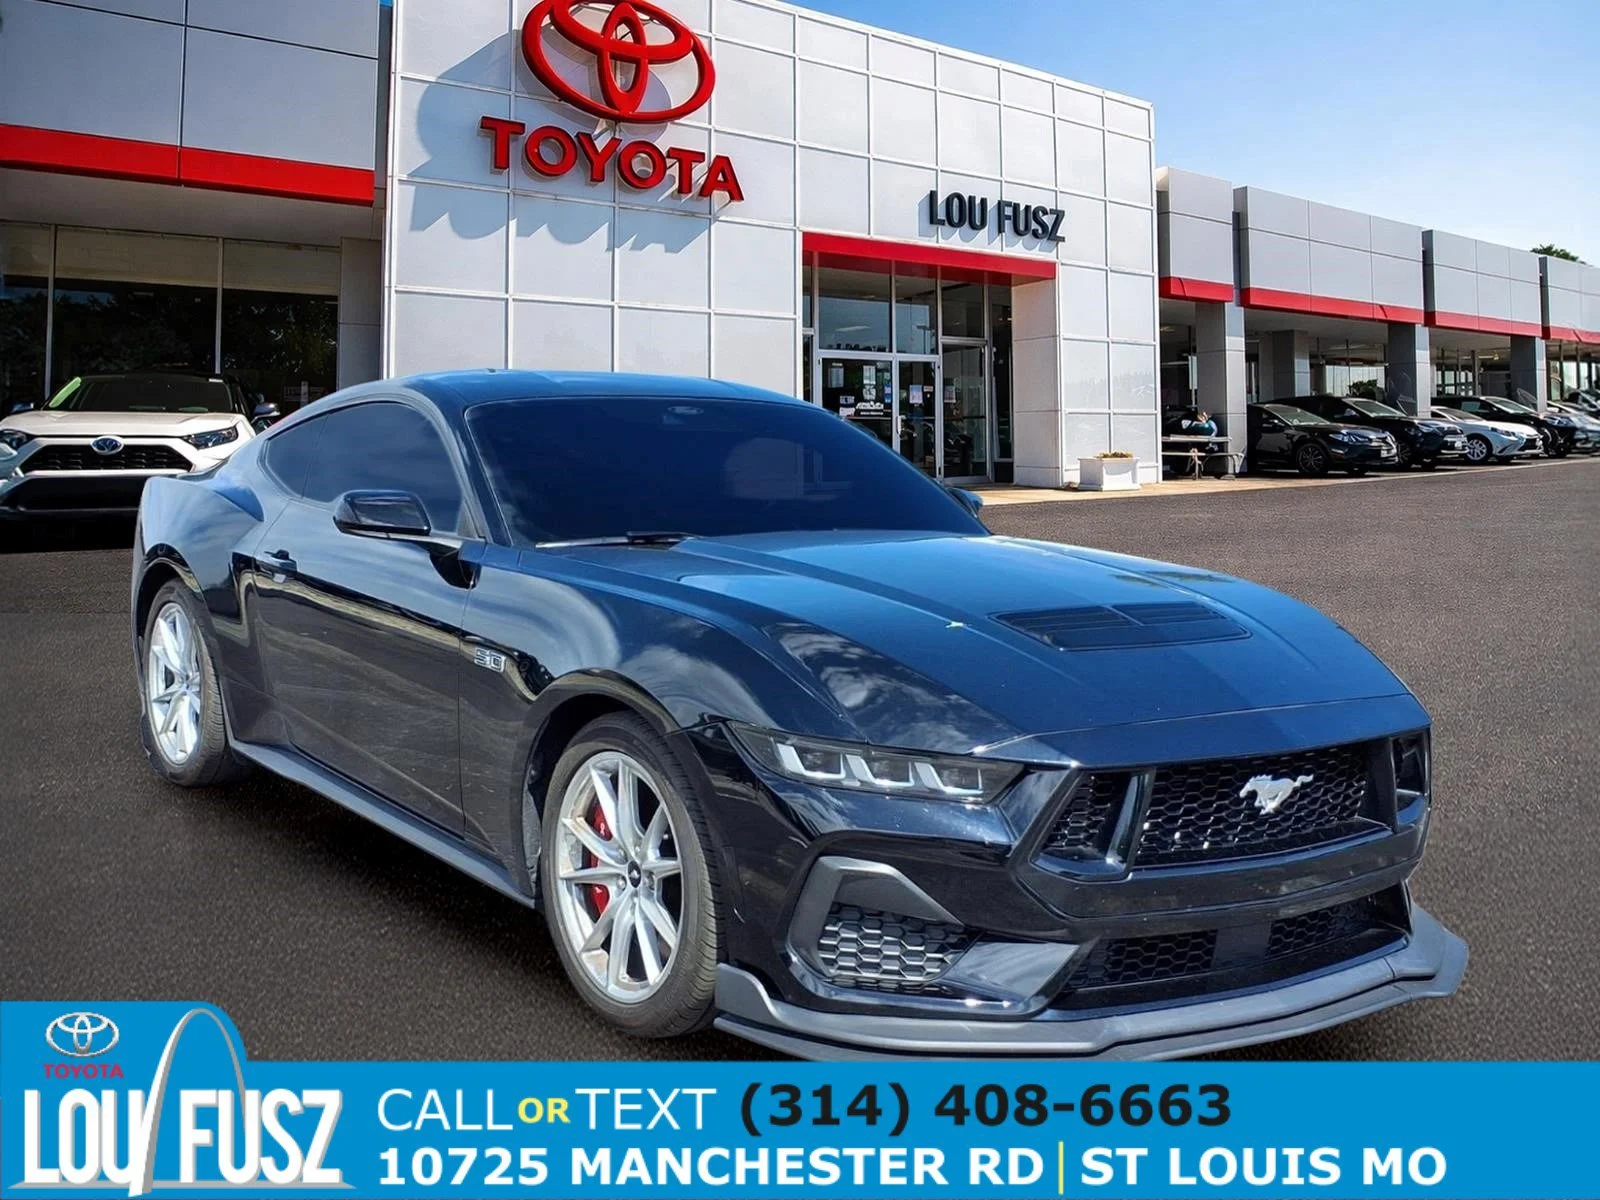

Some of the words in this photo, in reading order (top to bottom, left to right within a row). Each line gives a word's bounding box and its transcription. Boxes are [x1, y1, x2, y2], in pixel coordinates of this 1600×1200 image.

[480, 116, 744, 202] TOYOTA
[929, 190, 988, 231] LOU
[997, 199, 1066, 243] FUSZ
